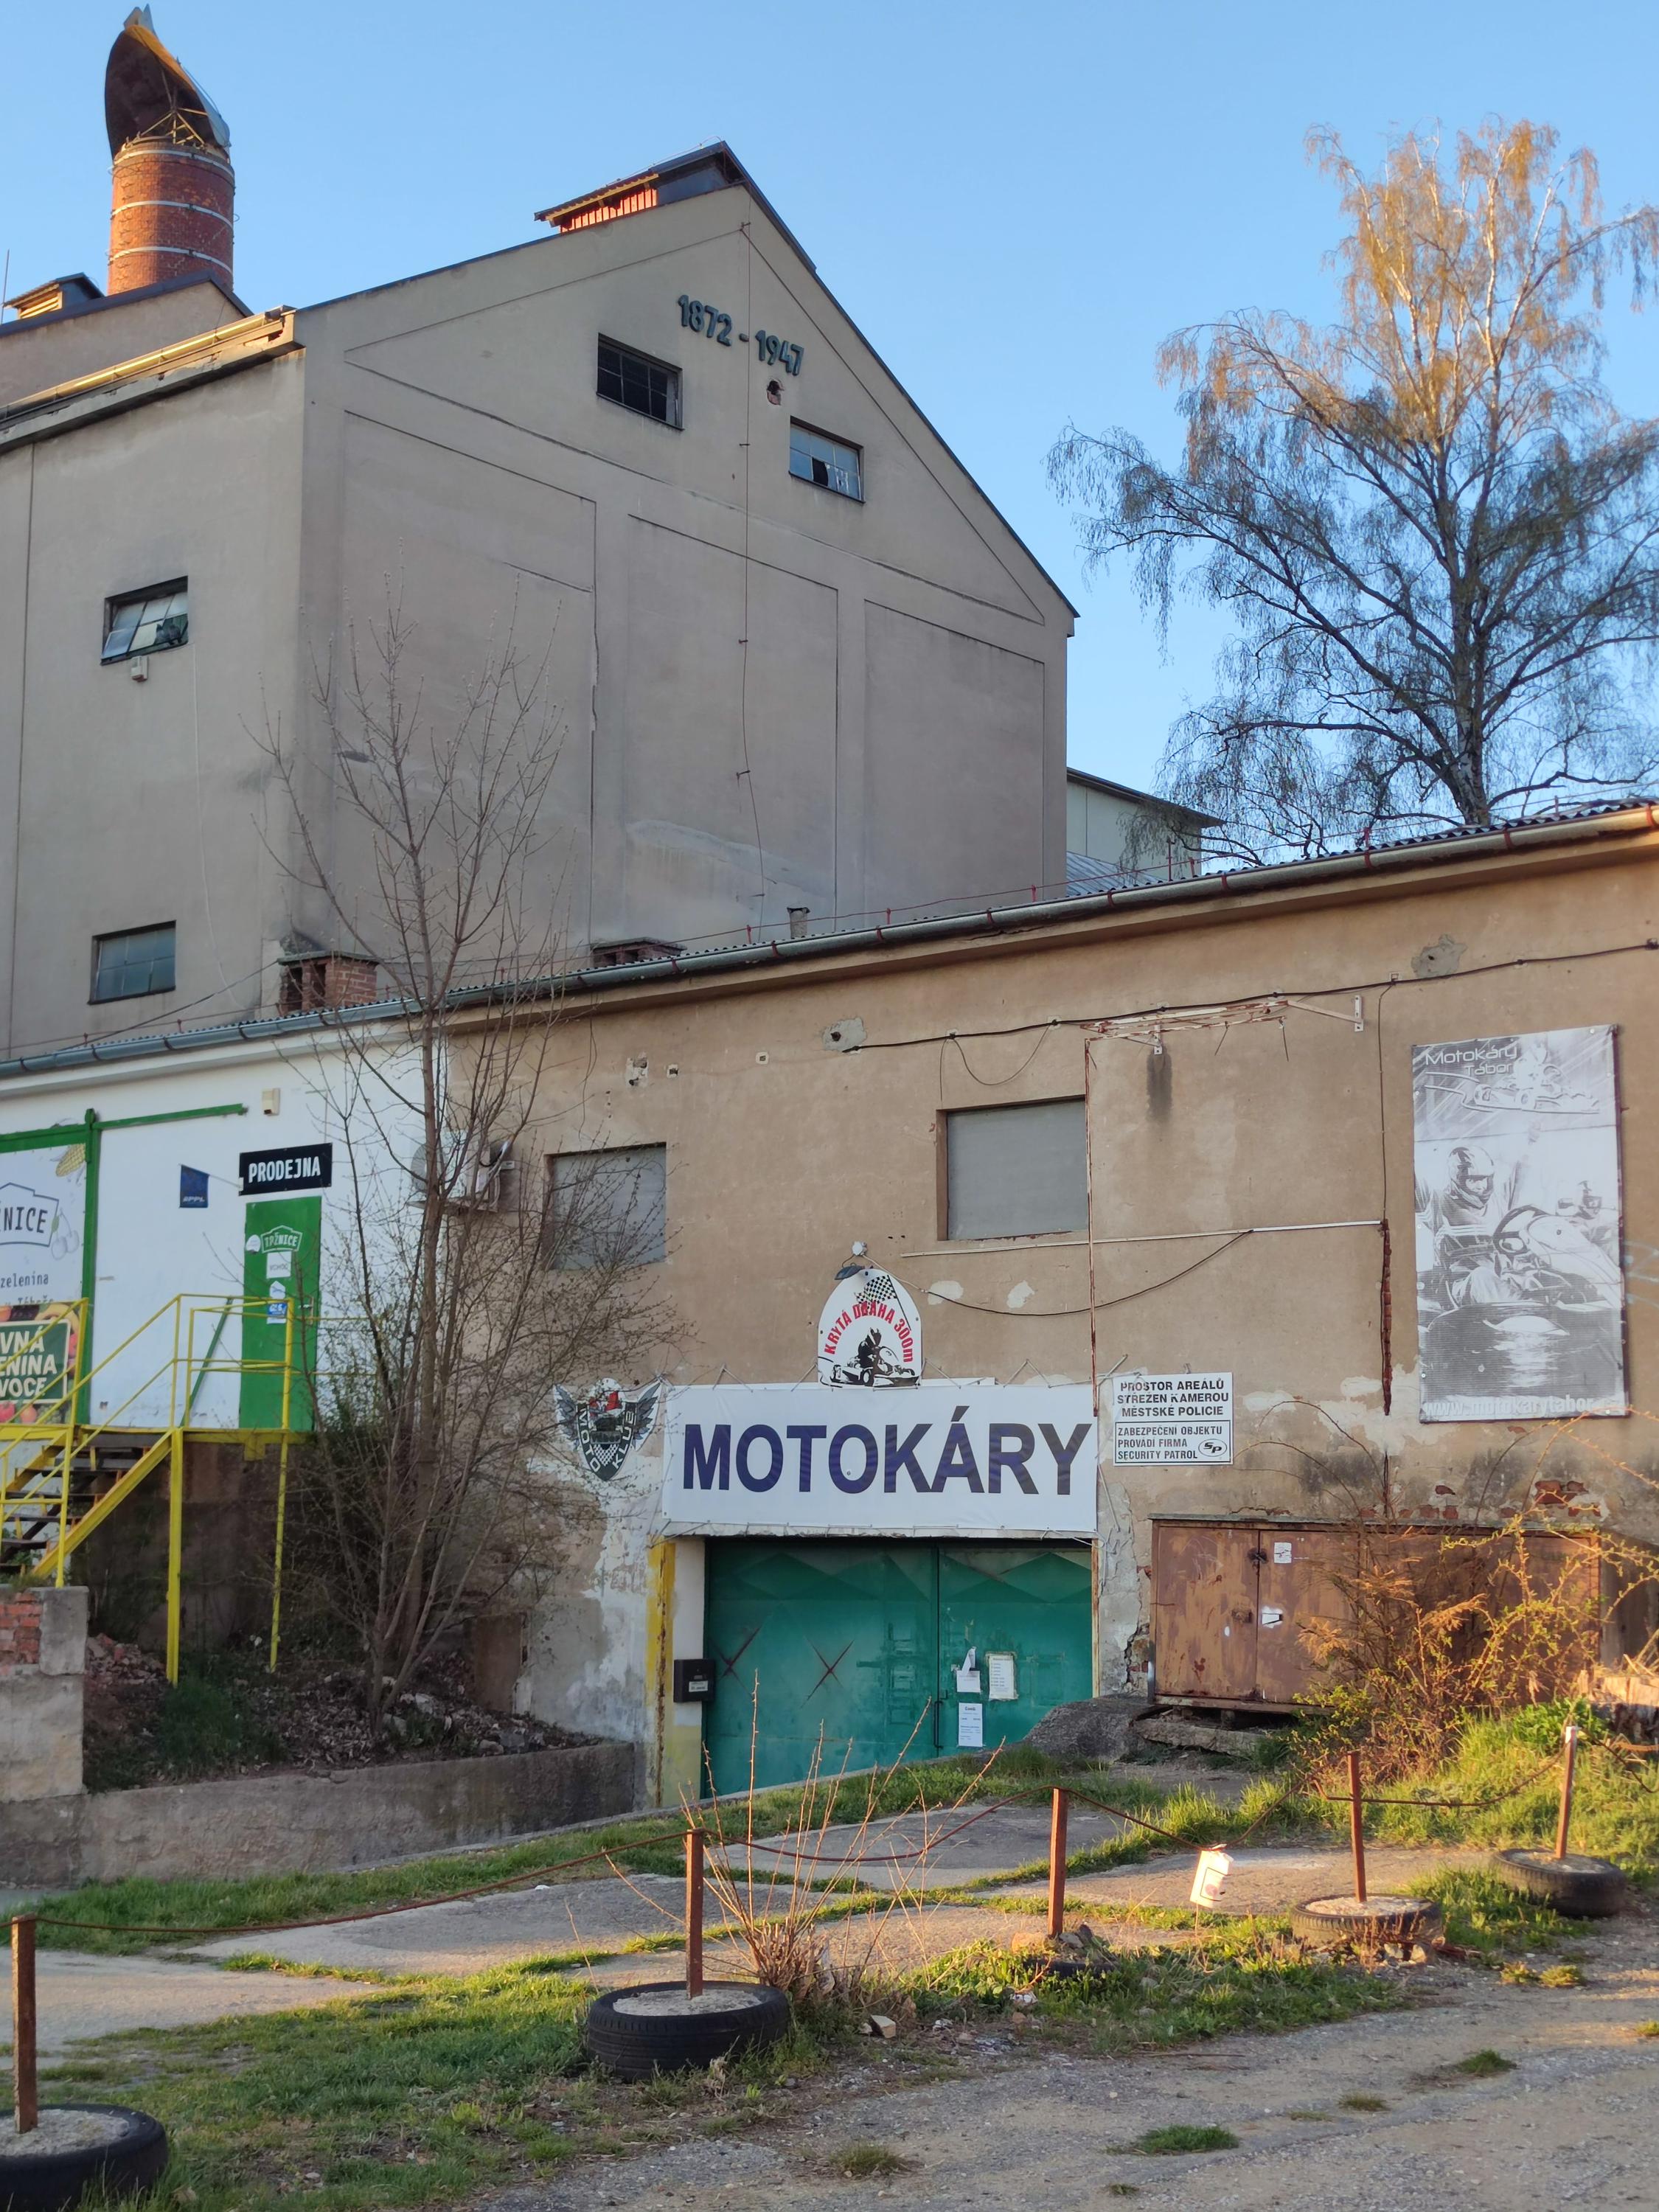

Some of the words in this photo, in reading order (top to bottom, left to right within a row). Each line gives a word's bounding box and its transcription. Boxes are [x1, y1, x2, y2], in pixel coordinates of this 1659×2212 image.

[678, 294, 732, 347] 1872
[755, 330, 805, 376] 1947
[1425, 1044, 1518, 1066] Motokáry
[1464, 1062, 1512, 1077] Tábor
[248, 1155, 321, 1183] PRODEJNA
[0, 1206, 49, 1234] NICE
[264, 1231, 299, 1248] TRŽNICE
[824, 1310, 853, 1356] KRYTÁ
[894, 1318, 914, 1363] 300m
[1120, 1381, 1173, 1392] PROSTOR
[1177, 1377, 1224, 1391] AREÁLŮ
[1117, 1392, 1167, 1405] STŘEŽEN
[1170, 1392, 1229, 1403] KAMEROU
[1121, 1404, 1175, 1417] MĚSTSKÉ
[1178, 1406, 1224, 1416] POLICIE
[1118, 1425, 1178, 1436] ZABEZPEČENÍ
[1180, 1426, 1222, 1436] OBJEKTU
[682, 1405, 1094, 1496] MOTOKÁRY
[1118, 1437, 1155, 1448] PROVÁDÍ
[1158, 1439, 1188, 1447] FIRMA
[1118, 1450, 1161, 1460] SECURITY
[1164, 1450, 1198, 1460] PATROL
